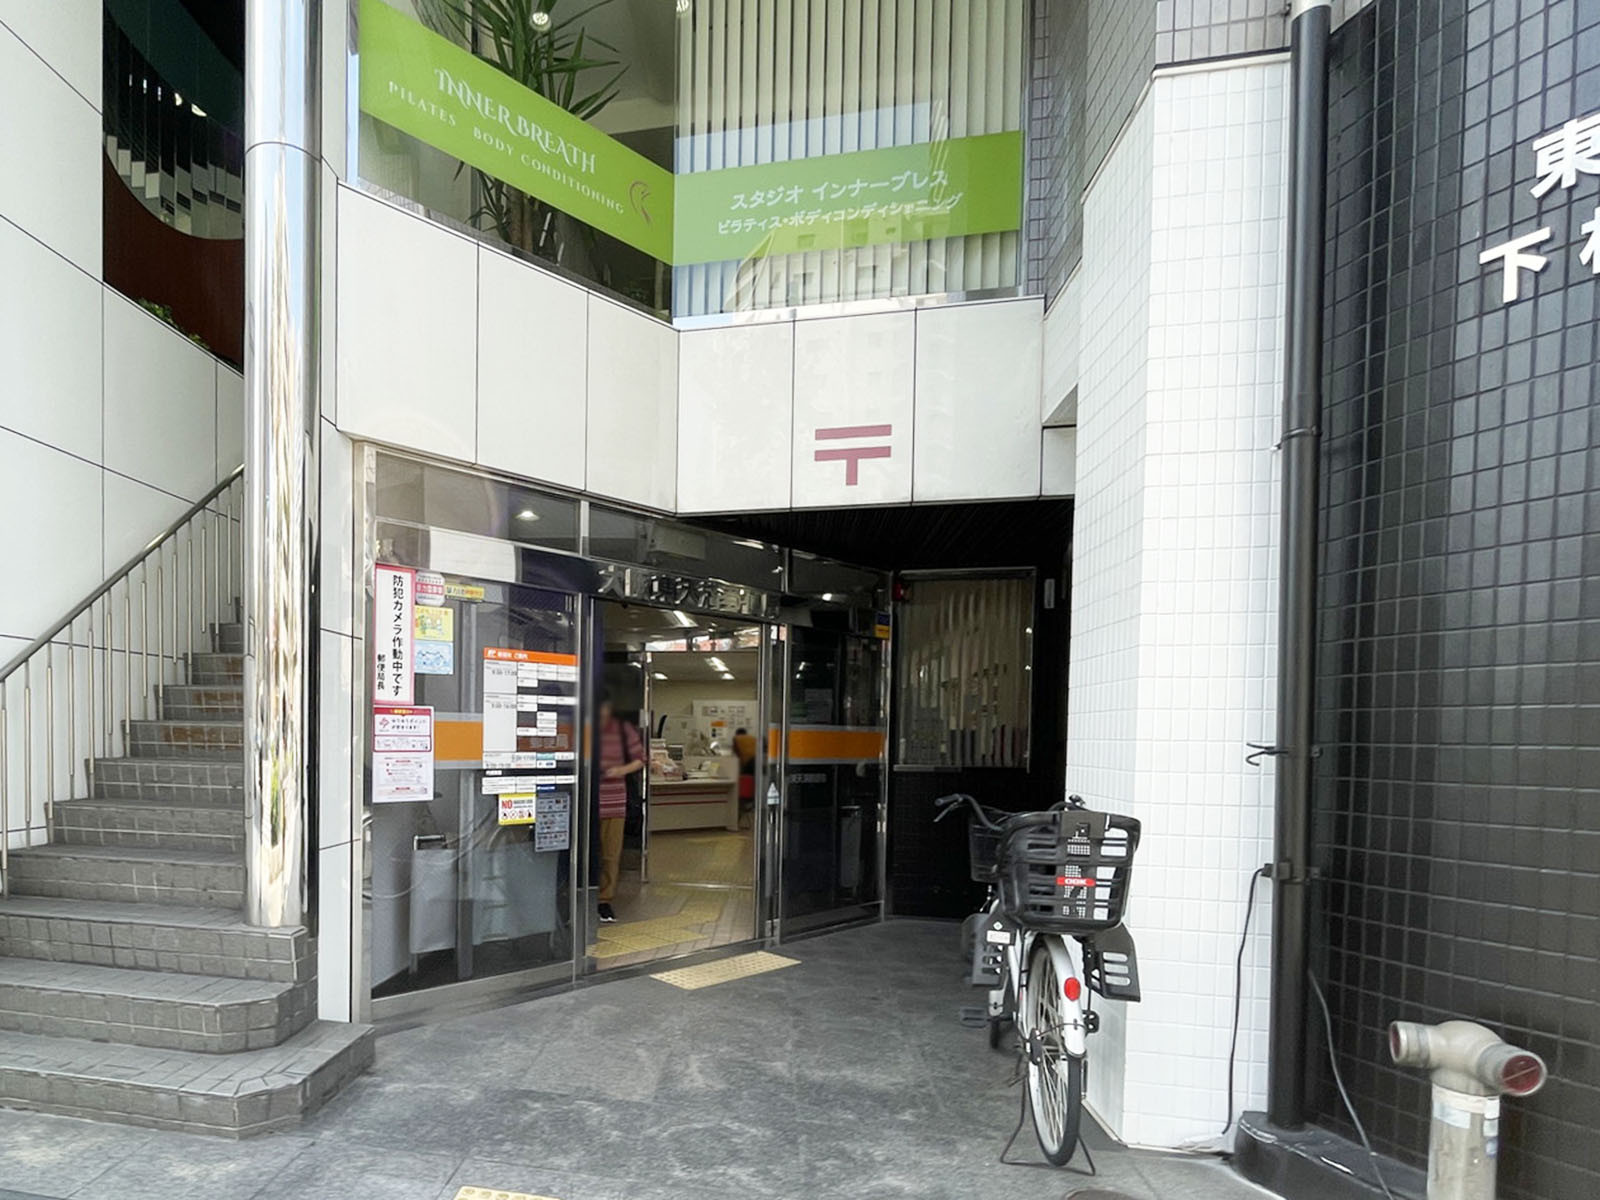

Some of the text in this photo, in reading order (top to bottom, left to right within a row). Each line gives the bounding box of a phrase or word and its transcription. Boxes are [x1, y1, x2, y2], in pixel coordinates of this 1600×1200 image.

[388, 80, 625, 215] PILATES BODY CONDITIONING
[434, 67, 597, 176] INNER BREATH
[731, 169, 949, 211] スタジオ インナーブレス
[392, 574, 404, 697] 防犯カメラ作動中です
[502, 800, 513, 809] NO
